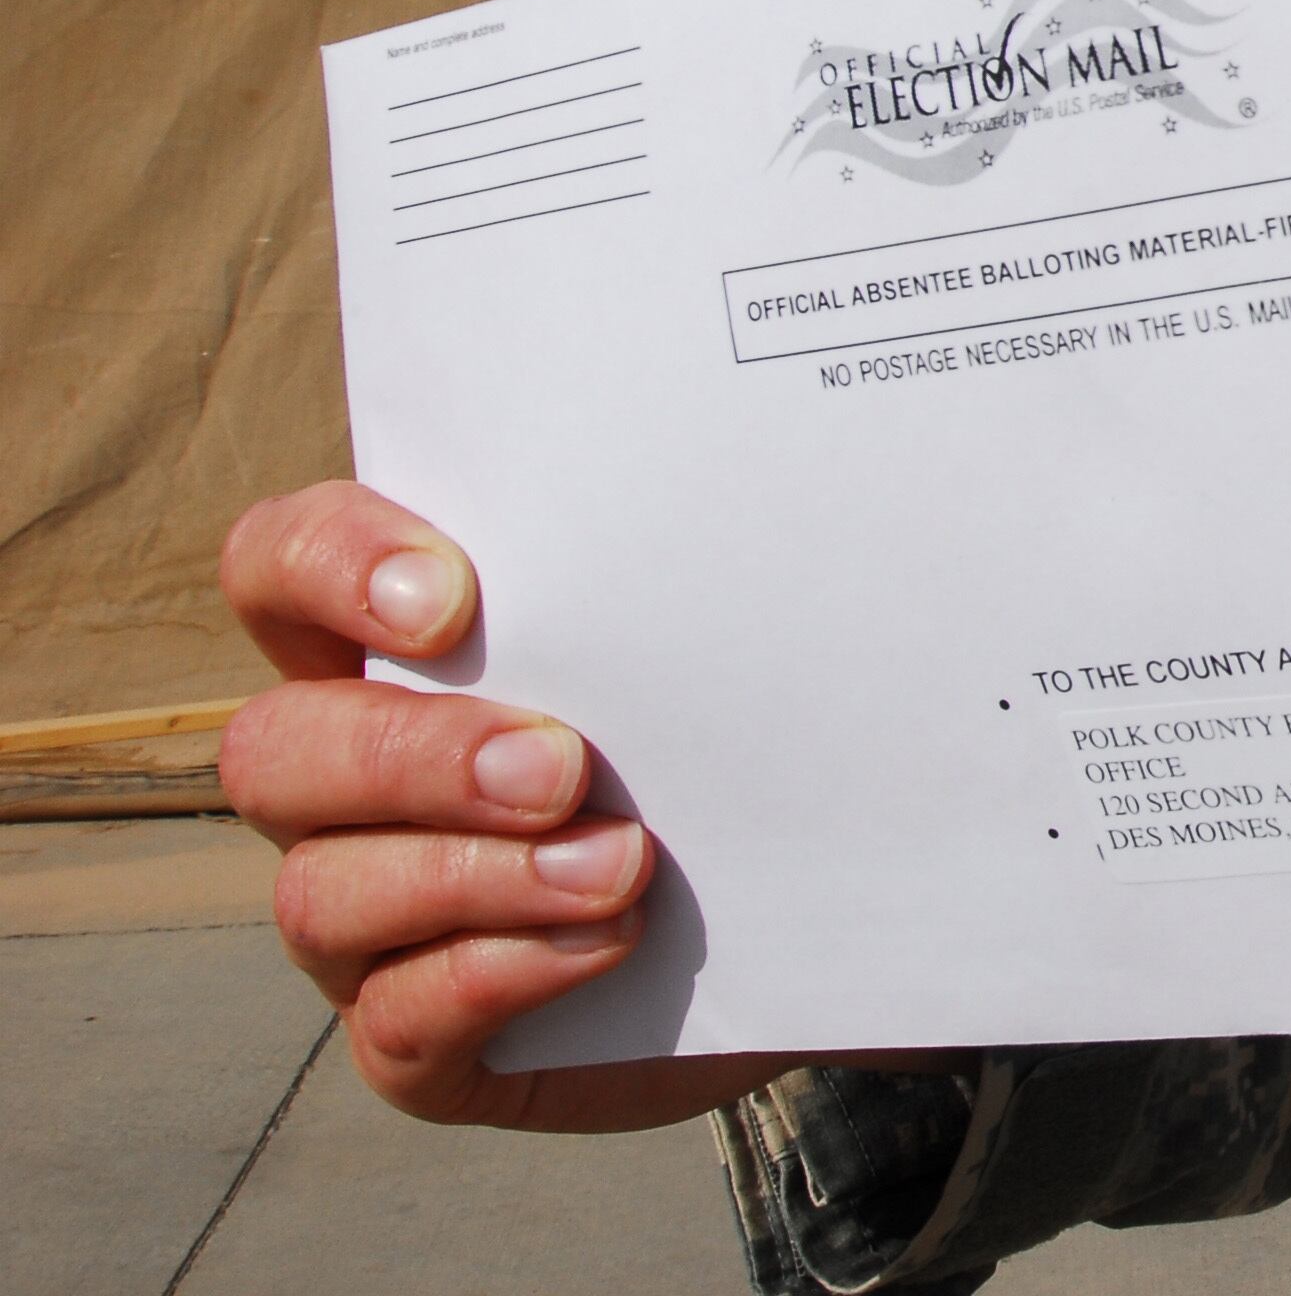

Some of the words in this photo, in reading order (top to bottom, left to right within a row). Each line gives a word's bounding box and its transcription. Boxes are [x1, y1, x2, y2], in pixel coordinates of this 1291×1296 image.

[387, 46, 411, 59] Name
[413, 40, 429, 53] and
[431, 31, 469, 47] complete
[472, 22, 505, 38] address
[819, 31, 993, 87] OFFICIAL
[844, 44, 1052, 129] ELECTION
[1067, 25, 1180, 88] MAIL
[1012, 107, 1029, 127] by
[1032, 102, 1054, 121] the
[1057, 95, 1085, 118] U.S.
[1089, 89, 1131, 112] Postal
[1135, 80, 1185, 104] Service
[747, 288, 846, 323] OFFICIAL
[851, 266, 974, 306] ABSENTEE
[980, 243, 1121, 287] BALLOTING
[820, 360, 852, 390] NO
[860, 347, 958, 384] POSTAGE
[965, 325, 1099, 368] NECESSARY
[1108, 320, 1132, 347] IN
[1140, 312, 1186, 343] THE
[1194, 304, 1240, 334] U.S.
[1032, 669, 1072, 696] TO
[1078, 662, 1140, 692] THE
[1145, 649, 1267, 685] COUNTY
[1071, 724, 1149, 753] POLK
[1153, 713, 1275, 746] COUNTY
[1084, 755, 1187, 785] OFFICE
[1099, 794, 1141, 819] 120
[1146, 783, 1263, 815] SECOND
[1107, 825, 1163, 852] DES
[1169, 816, 1291, 846] MOINES,
